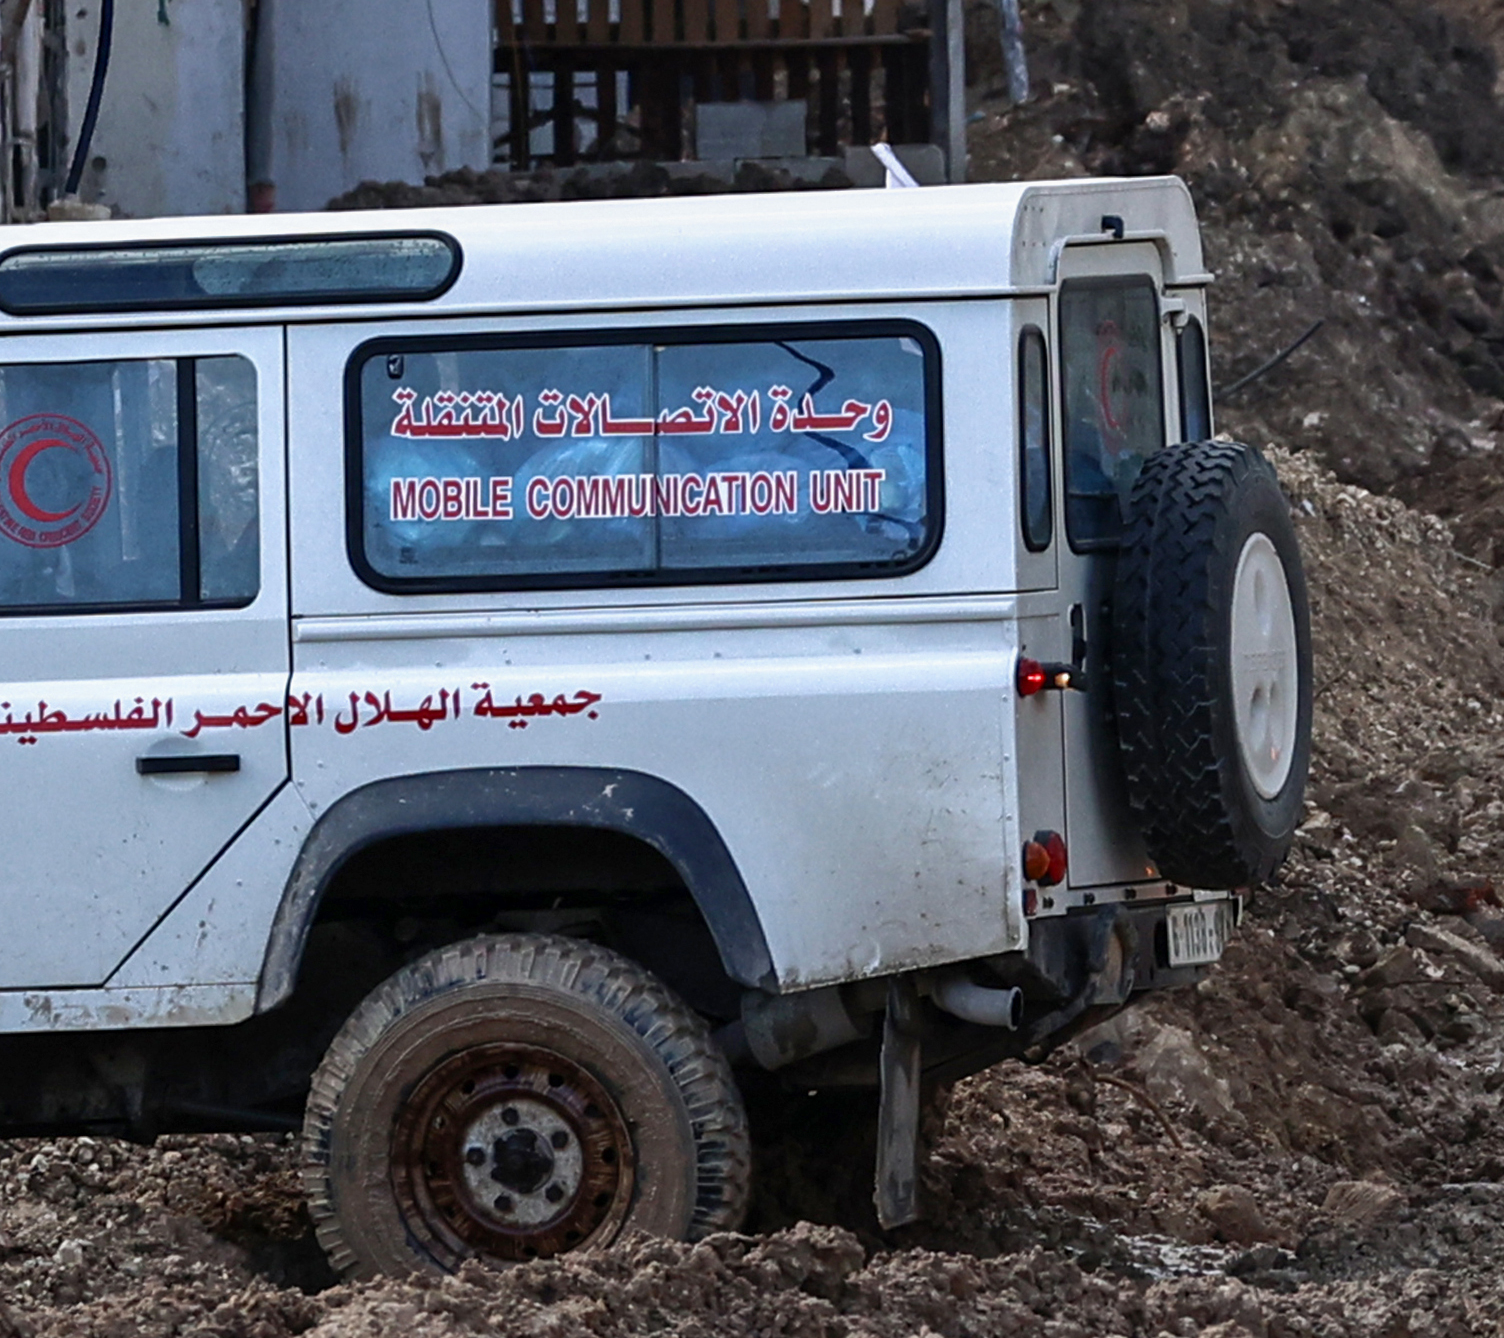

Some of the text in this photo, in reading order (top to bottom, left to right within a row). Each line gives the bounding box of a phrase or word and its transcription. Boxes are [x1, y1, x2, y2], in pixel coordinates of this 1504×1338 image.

[390, 384, 893, 442] وحدة الاتصالات المتنقلة
[390, 469, 886, 521] MOBILE COMMUNICATION UNIT
[180, 691, 325, 738] الاحمر
[333, 686, 461, 734] الهلال
[472, 681, 603, 730] جمعية
